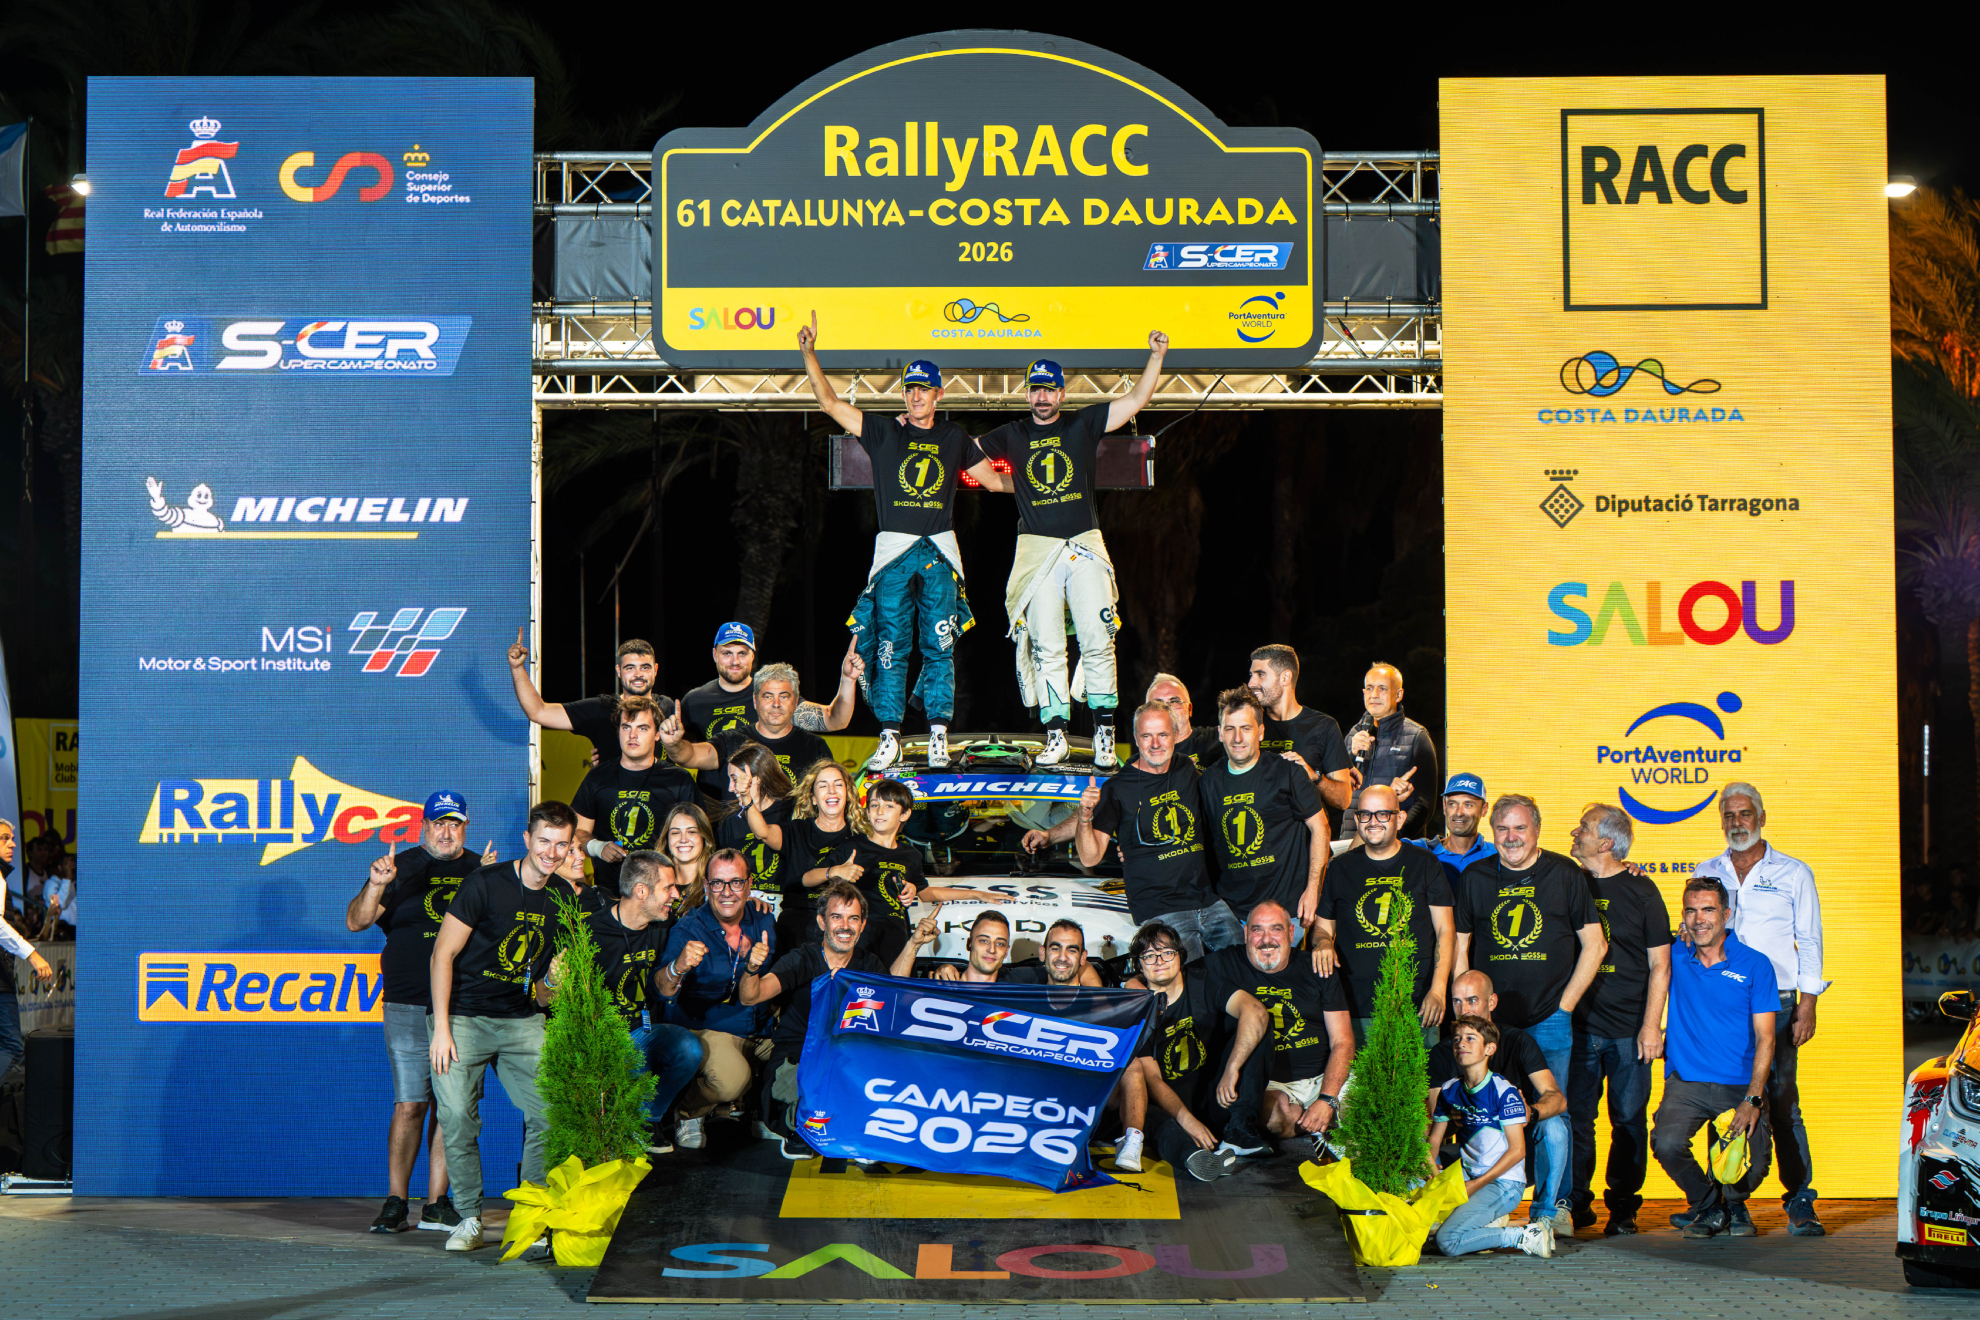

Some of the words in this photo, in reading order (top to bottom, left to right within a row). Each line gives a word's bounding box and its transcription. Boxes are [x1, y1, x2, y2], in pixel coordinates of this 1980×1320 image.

[824, 121, 1149, 192] RallyRACC
[406, 171, 450, 182] Consejo
[1580, 144, 1748, 205] RACC
[406, 182, 452, 194] Superior
[406, 193, 420, 203] de
[421, 193, 471, 204] Deportes
[144, 208, 164, 219] Real
[166, 207, 218, 219] Federación
[220, 208, 263, 221] Española
[676, 199, 711, 227] 61
[1083, 197, 1298, 226] DAURADA
[161, 222, 172, 232] de
[174, 222, 247, 232] Automovilismo
[958, 241, 1013, 263] 2026
[689, 307, 775, 330] SALOU
[1228, 311, 1286, 321] PortAventura
[1241, 320, 1273, 328] WORLD
[931, 329, 974, 338] COSTA
[977, 329, 1042, 338] DAURADA
[1537, 408, 1617, 424] COSTA
[1624, 407, 1744, 424] DAURADA
[915, 458, 930, 487] 1
[1041, 452, 1055, 484] 1
[230, 496, 470, 523] MICHELIN
[1595, 493, 1694, 517] Diputació
[1697, 494, 1800, 517] Tarragona
[1547, 580, 1796, 647] SALOU
[261, 626, 332, 653] MSi
[260, 656, 331, 671] Institute
[1597, 745, 1741, 764] PortAventura
[55, 773, 76, 783] Club
[1631, 767, 1709, 784] WORLD
[624, 806, 640, 837] 1
[1165, 806, 1181, 836] 1
[1232, 810, 1247, 845] 1
[751, 843, 765, 874] 1
[1158, 847, 1190, 860] SKODA
[1660, 862, 1669, 873] &
[1375, 892, 1392, 925] 1
[1507, 903, 1525, 937] 1
[1355, 941, 1387, 949] SKODA
[1489, 953, 1519, 961] SKODA
[1267, 1003, 1284, 1029] 1
[1175, 1035, 1189, 1071] 1
[864, 1078, 1096, 1126] CAMPEÓN
[864, 1108, 1082, 1165] 2026
[1928, 1226, 1965, 1243] PIRELLI
[661, 1242, 1288, 1280] SALOU
